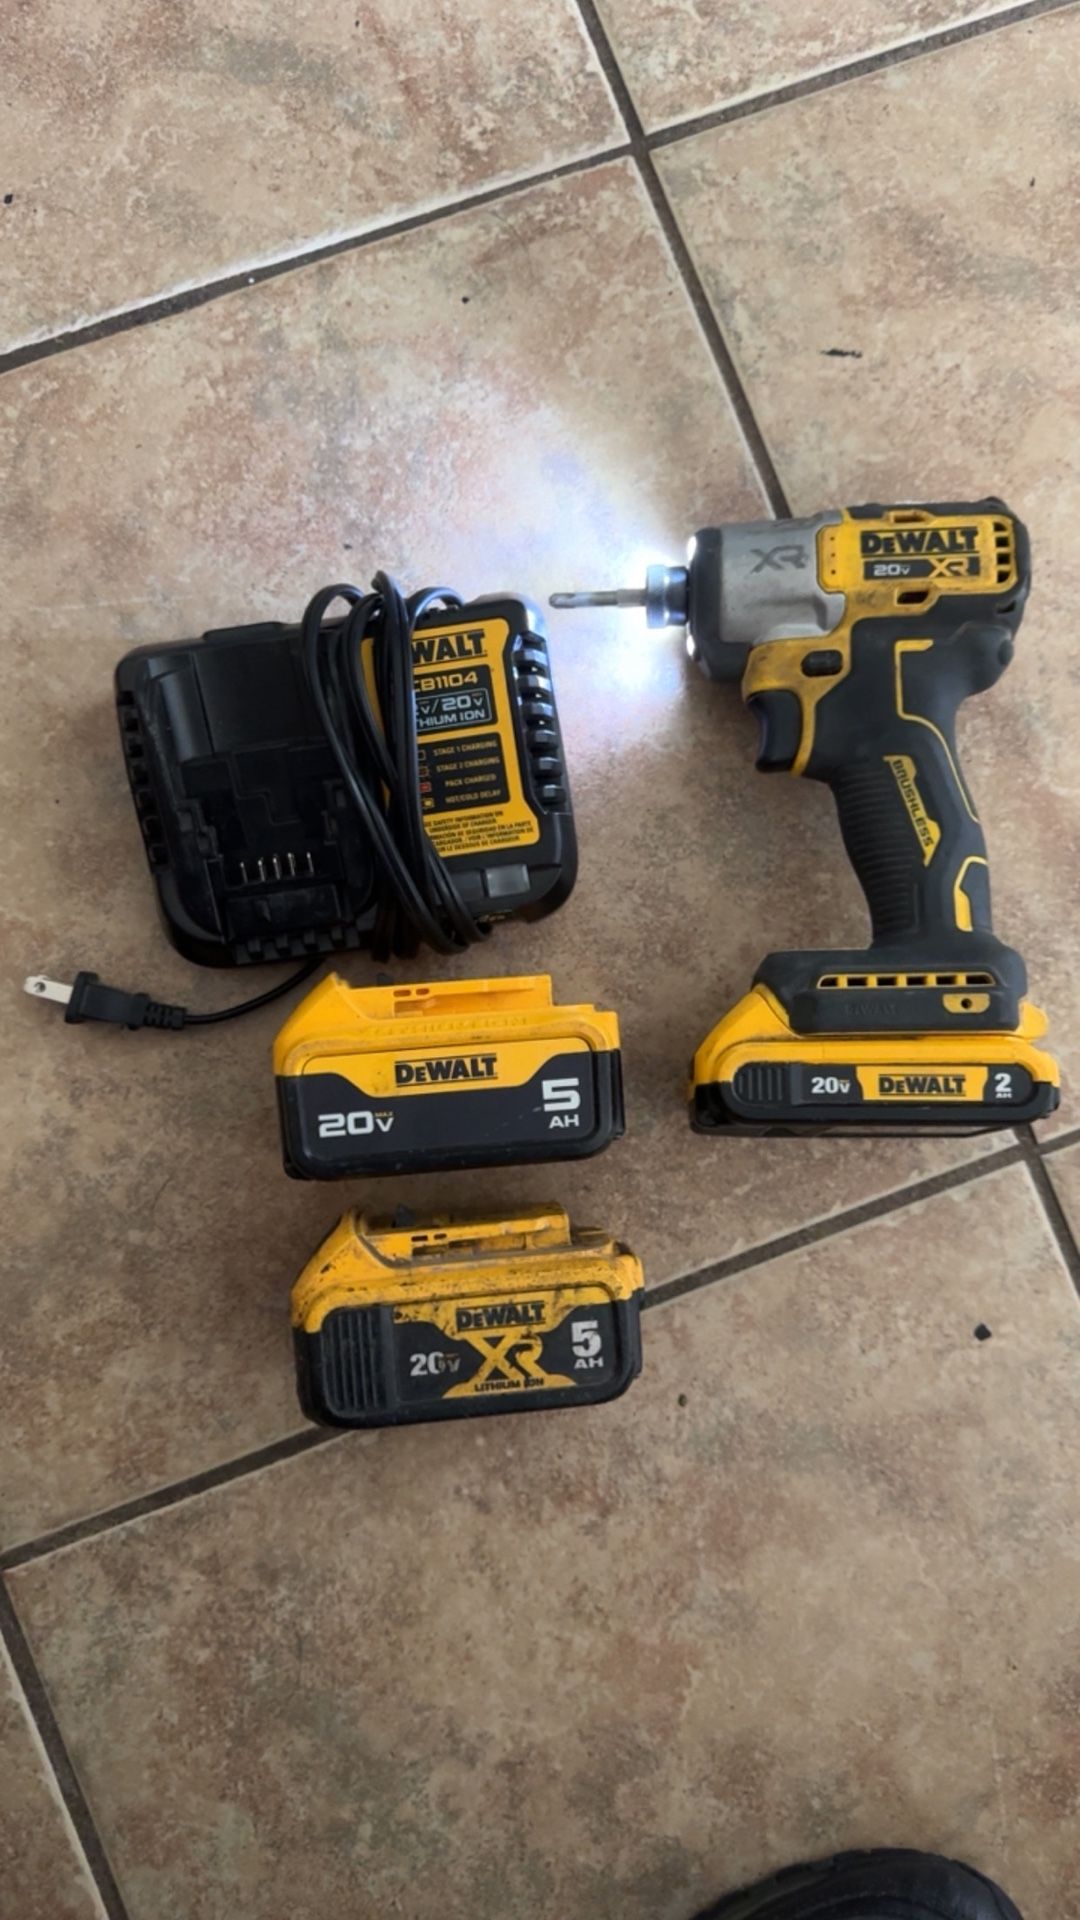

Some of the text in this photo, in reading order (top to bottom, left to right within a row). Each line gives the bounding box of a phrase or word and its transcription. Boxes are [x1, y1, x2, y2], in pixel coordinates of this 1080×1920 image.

[861, 528, 979, 556] DEWALT
[751, 544, 810, 574] XR
[928, 558, 971, 579] XR
[411, 631, 486, 664] WALT
[413, 671, 478, 692] B1104
[460, 709, 485, 721] ION
[892, 759, 935, 848] BRUSHLESS
[395, 1056, 498, 1085] DEWALT
[811, 1072, 1012, 1095] 20V DEWALT 2
[542, 1077, 581, 1113] 5
[549, 1114, 580, 1129] AH
[456, 1303, 546, 1330] DEWALT
[571, 1320, 602, 1357] 5
[464, 1332, 549, 1379] XR
[573, 1357, 604, 1369] AH
[474, 1380, 521, 1392] LITHIUM
